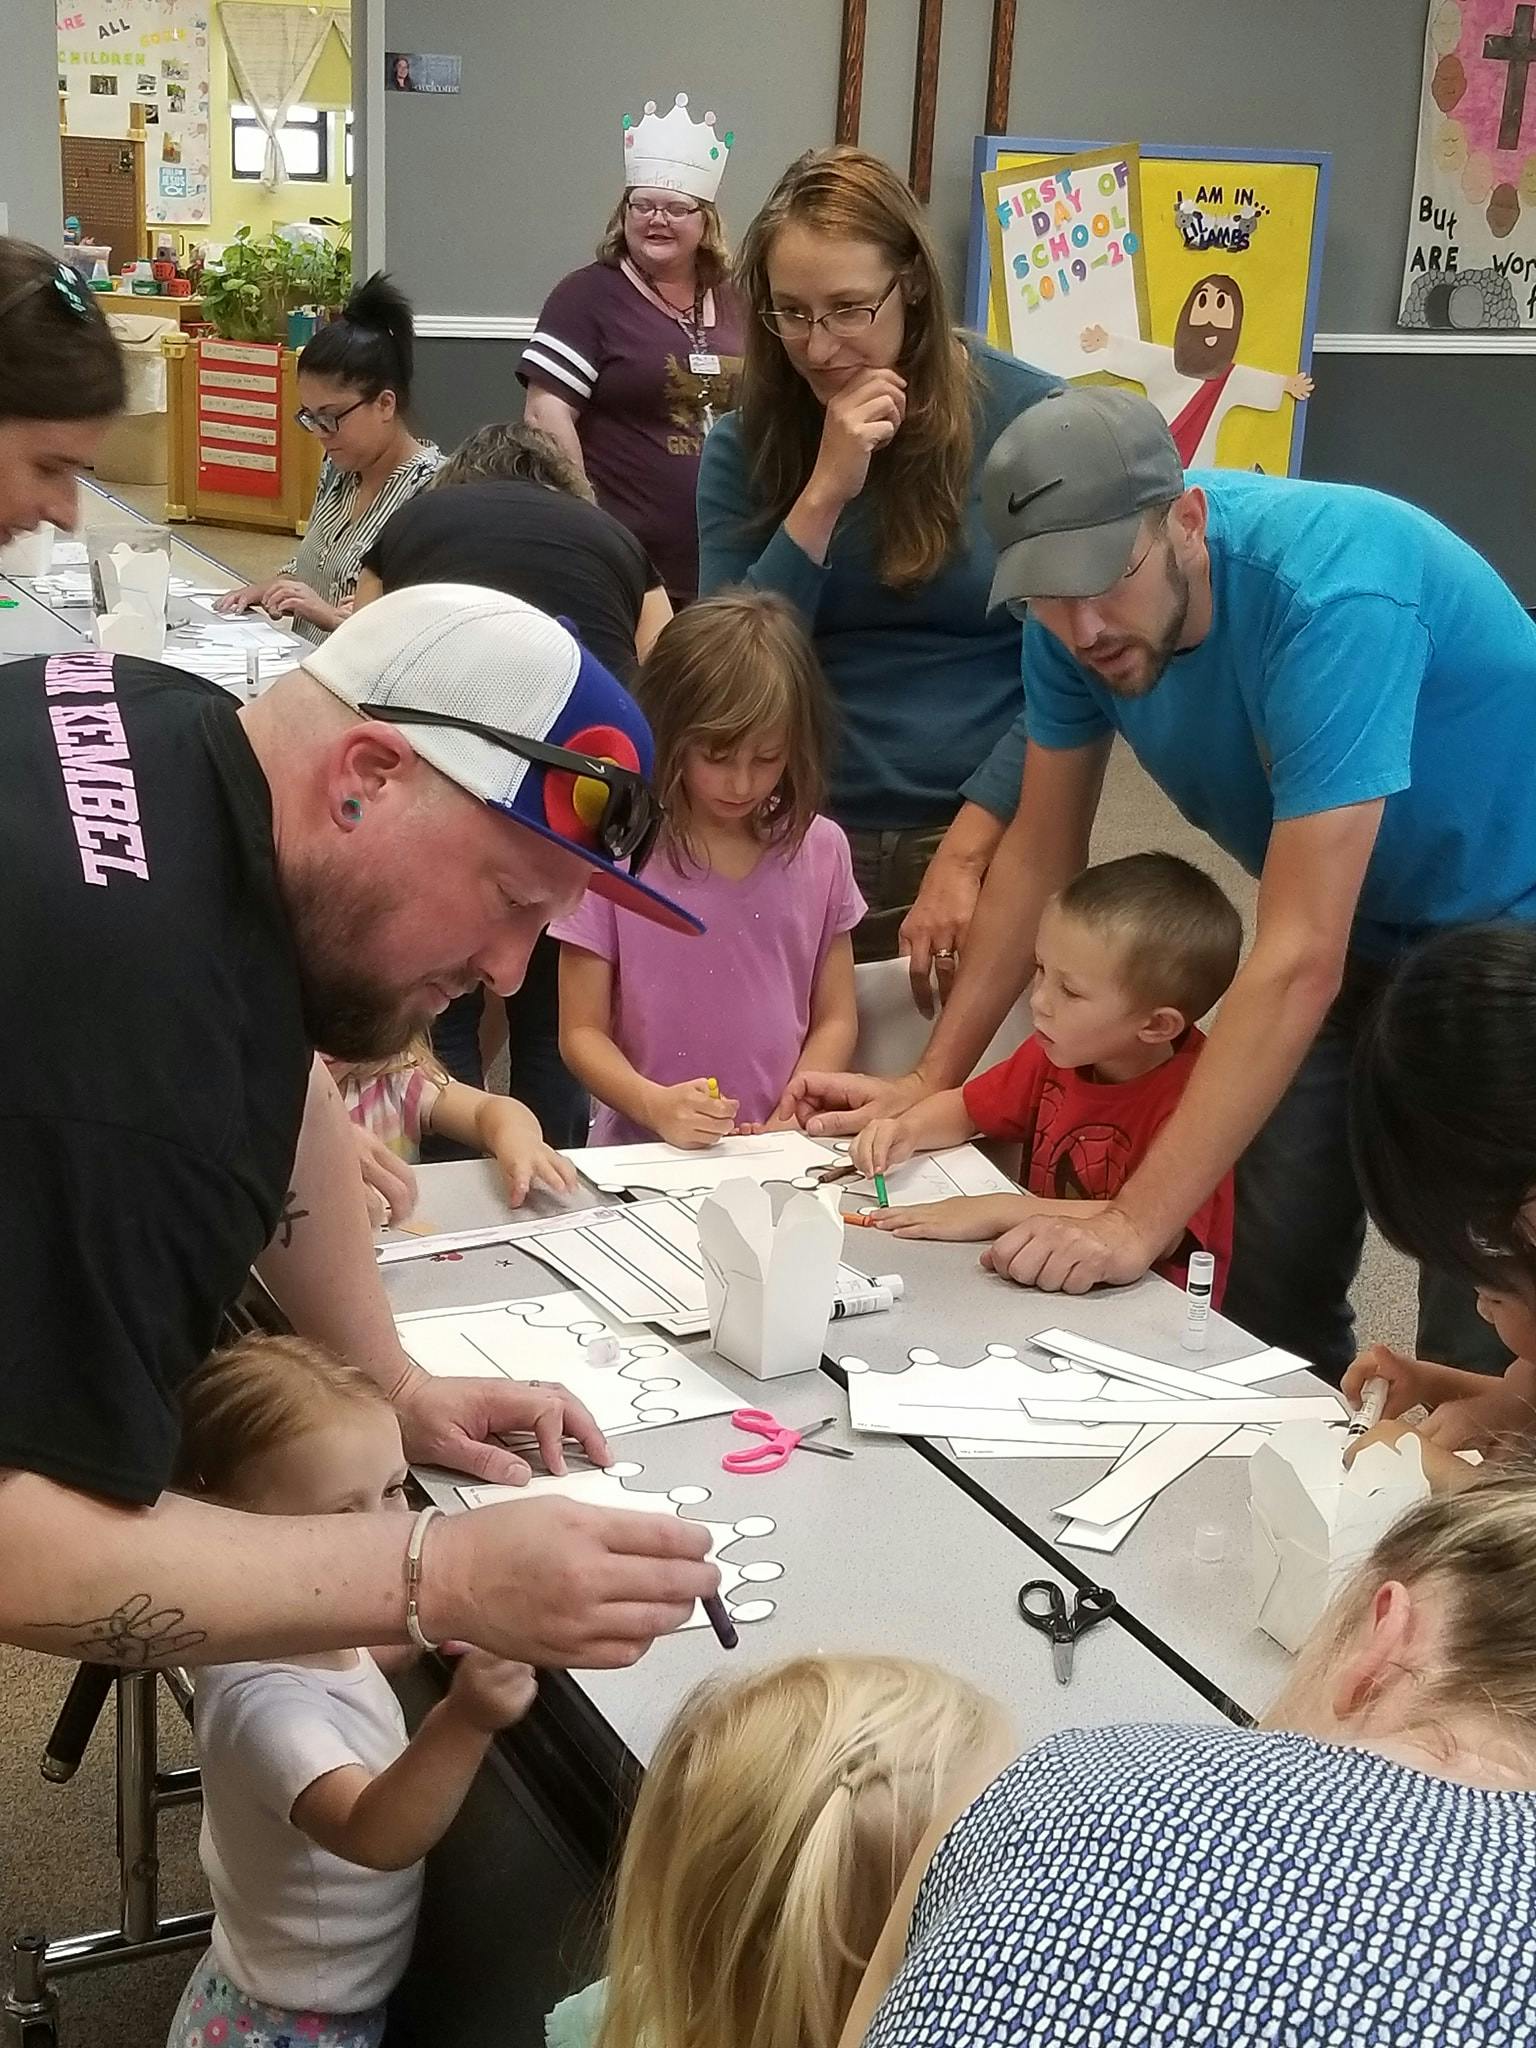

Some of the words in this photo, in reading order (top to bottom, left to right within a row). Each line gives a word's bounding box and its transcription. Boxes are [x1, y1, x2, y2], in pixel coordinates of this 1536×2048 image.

[99, 18, 131, 39] ALL
[58, 51, 146, 65] CHILDREN
[995, 169, 1073, 230] FIRST
[1098, 161, 1130, 197] OF
[1031, 188, 1083, 237] DAY
[1196, 186, 1223, 204] AM
[1418, 195, 1458, 240] But
[1012, 206, 1127, 280] SCHOOL
[1409, 245, 1460, 272] ARE
[47, 701, 150, 887] KEMBEL
